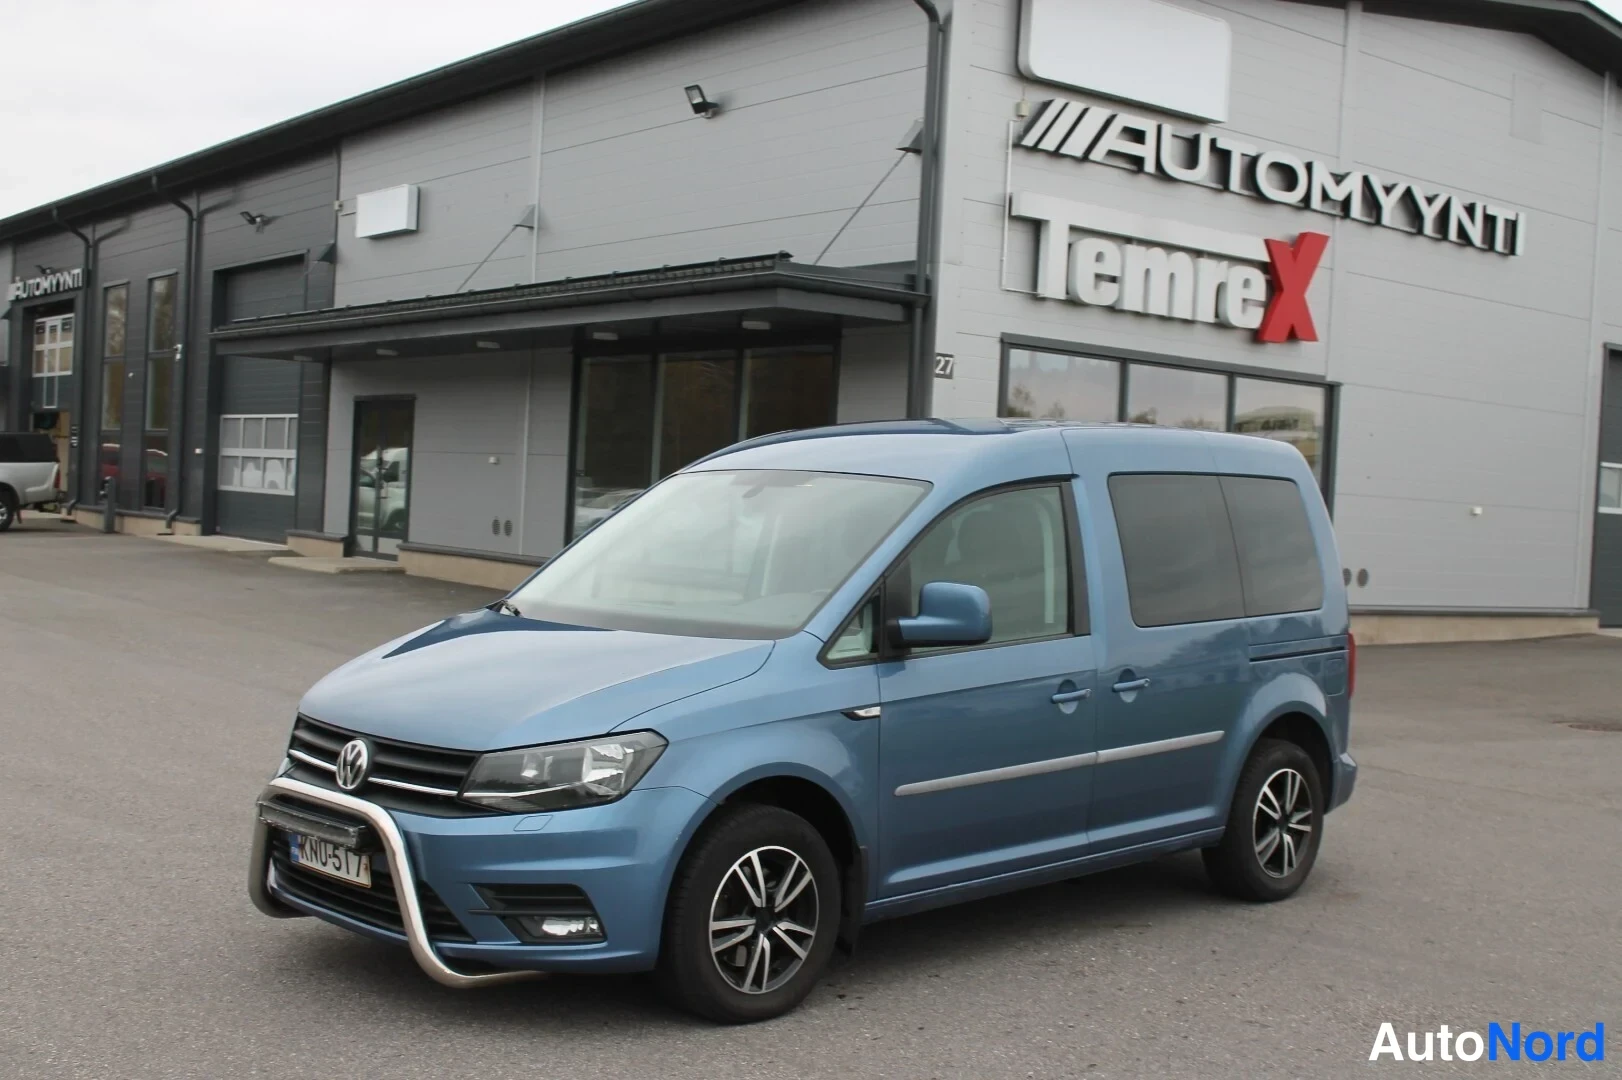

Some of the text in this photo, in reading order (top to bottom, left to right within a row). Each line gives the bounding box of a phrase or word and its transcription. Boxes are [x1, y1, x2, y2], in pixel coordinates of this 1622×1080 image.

[1089, 112, 1526, 257] AUTOMYYNTI
[12, 268, 83, 300] AUTOMYYNTI
[935, 356, 953, 375] 27
